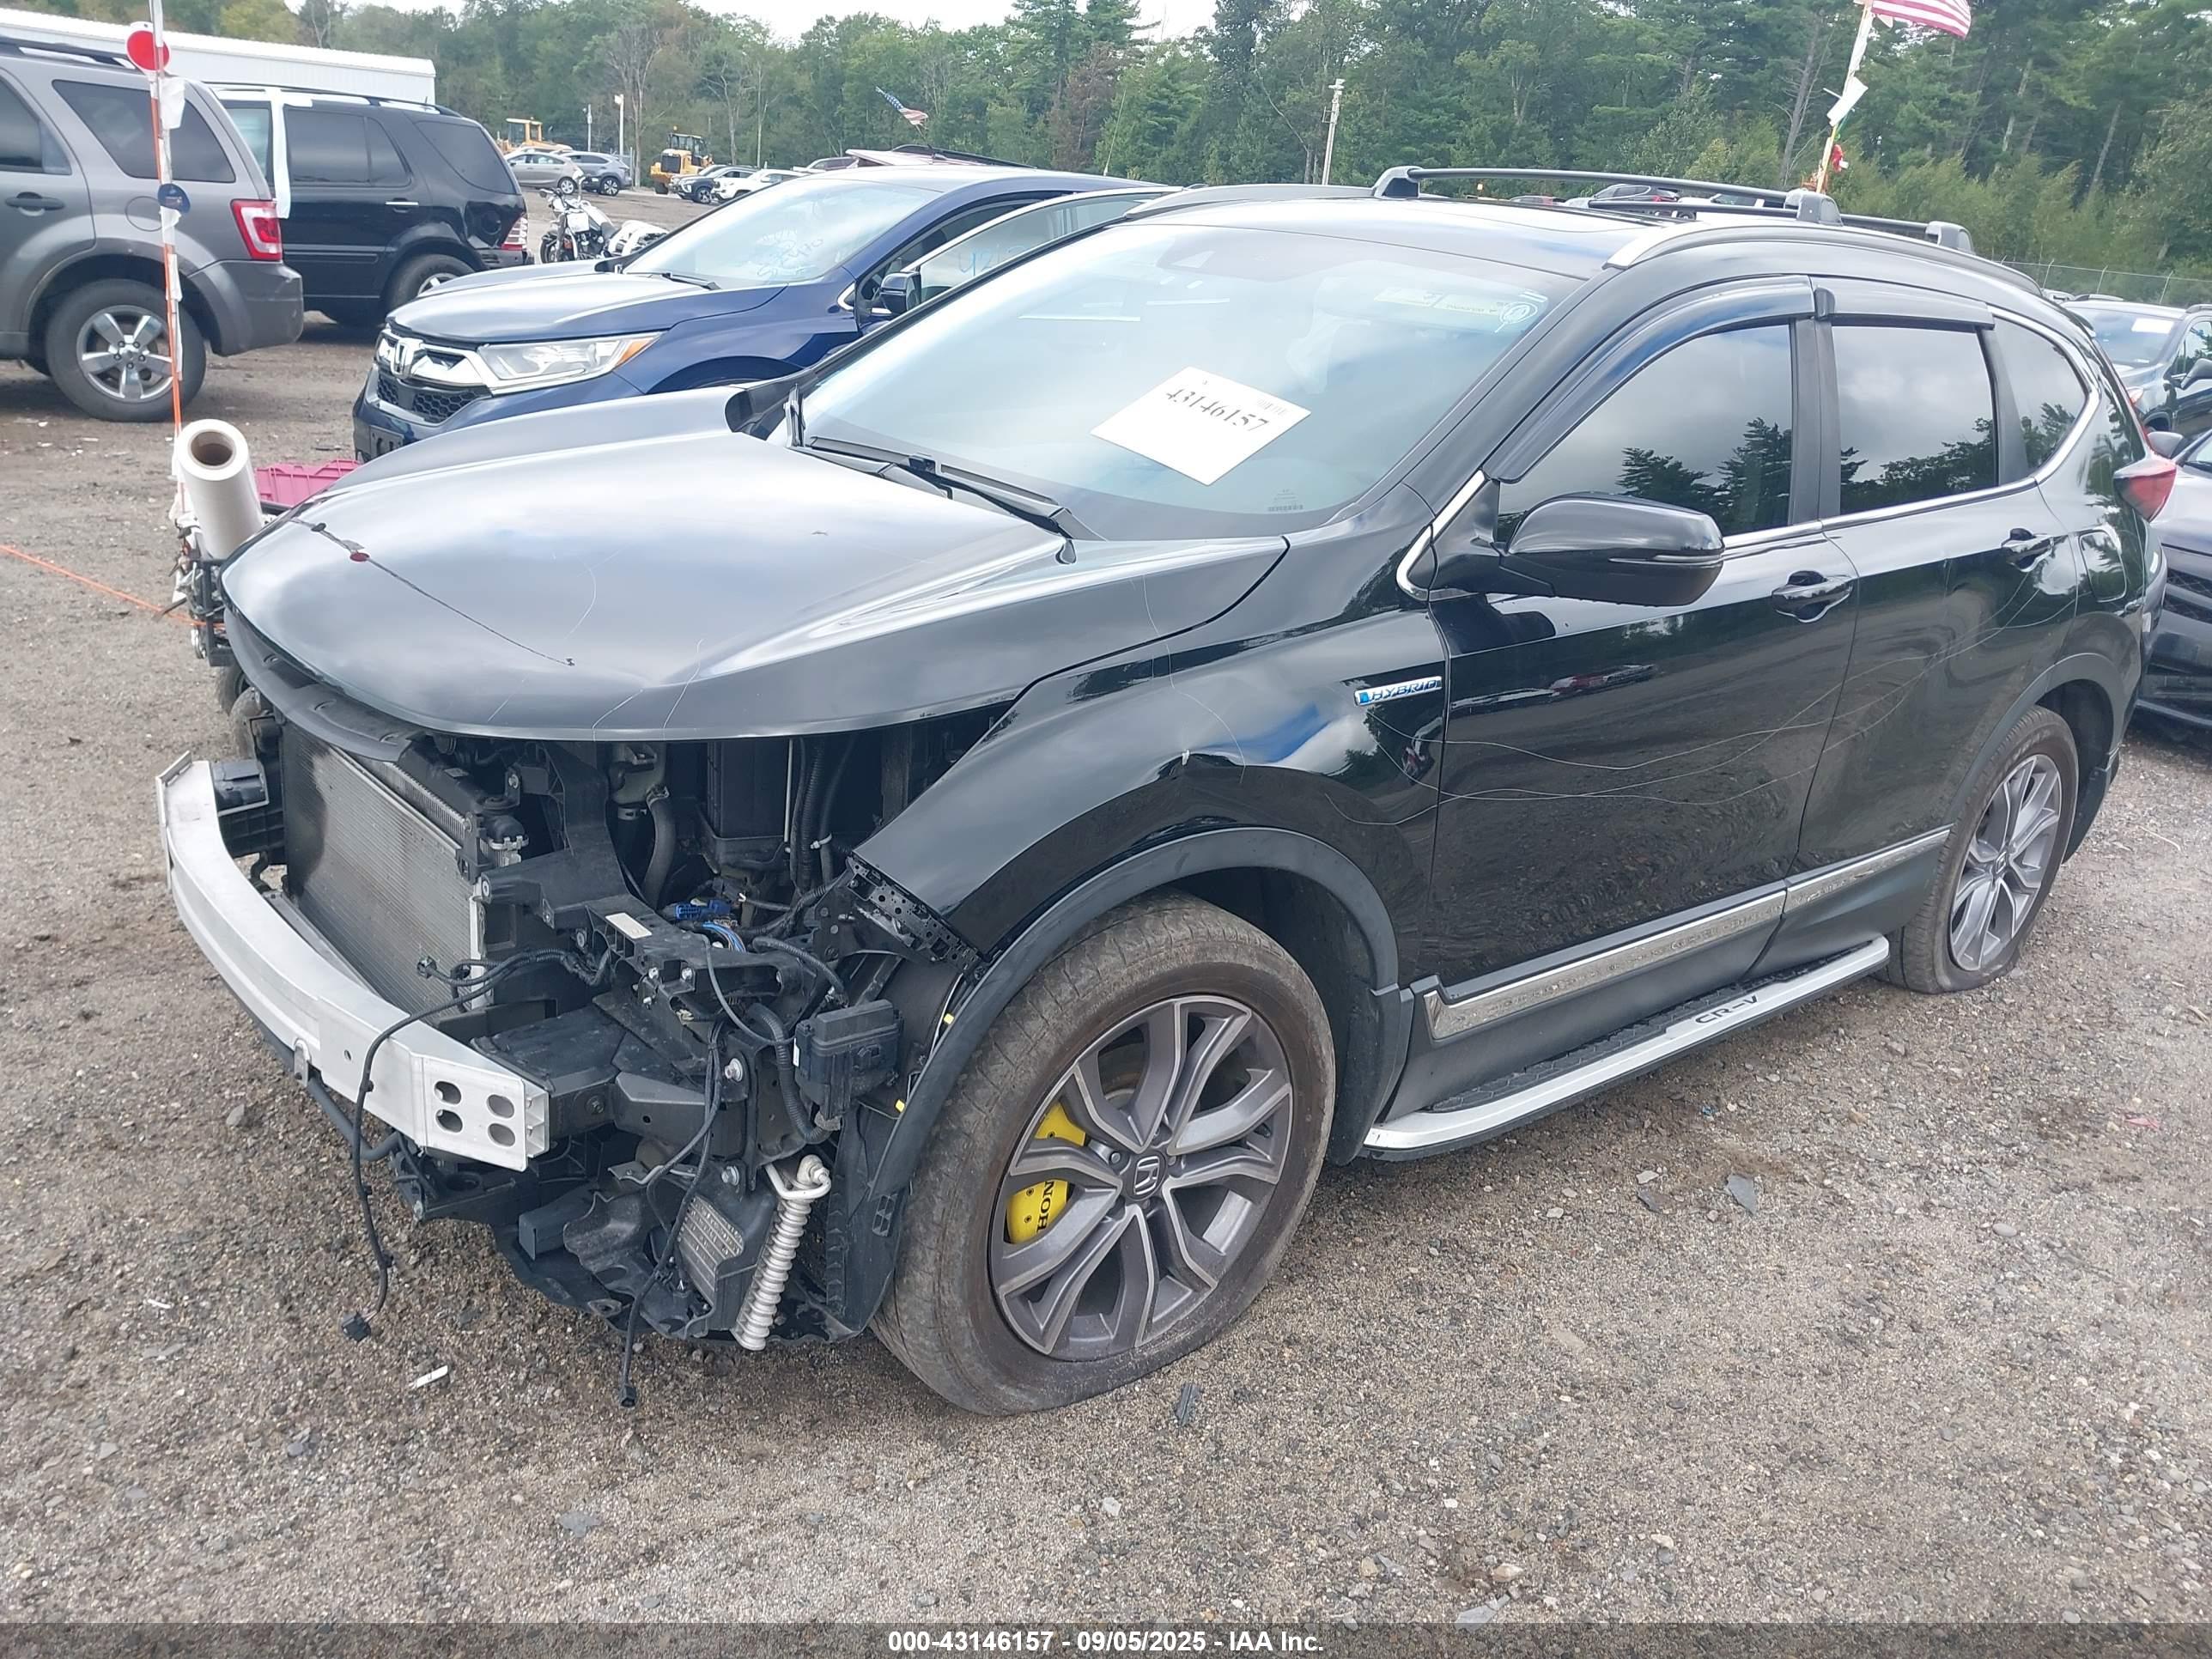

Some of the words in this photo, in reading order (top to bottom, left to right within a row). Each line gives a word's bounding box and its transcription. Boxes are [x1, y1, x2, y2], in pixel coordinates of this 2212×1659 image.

[1165, 388, 1269, 431] 43146157
[1370, 679, 1438, 702] HYBRID
[1695, 994, 1758, 1024] CR-V
[1036, 1181, 1054, 1233] HON
